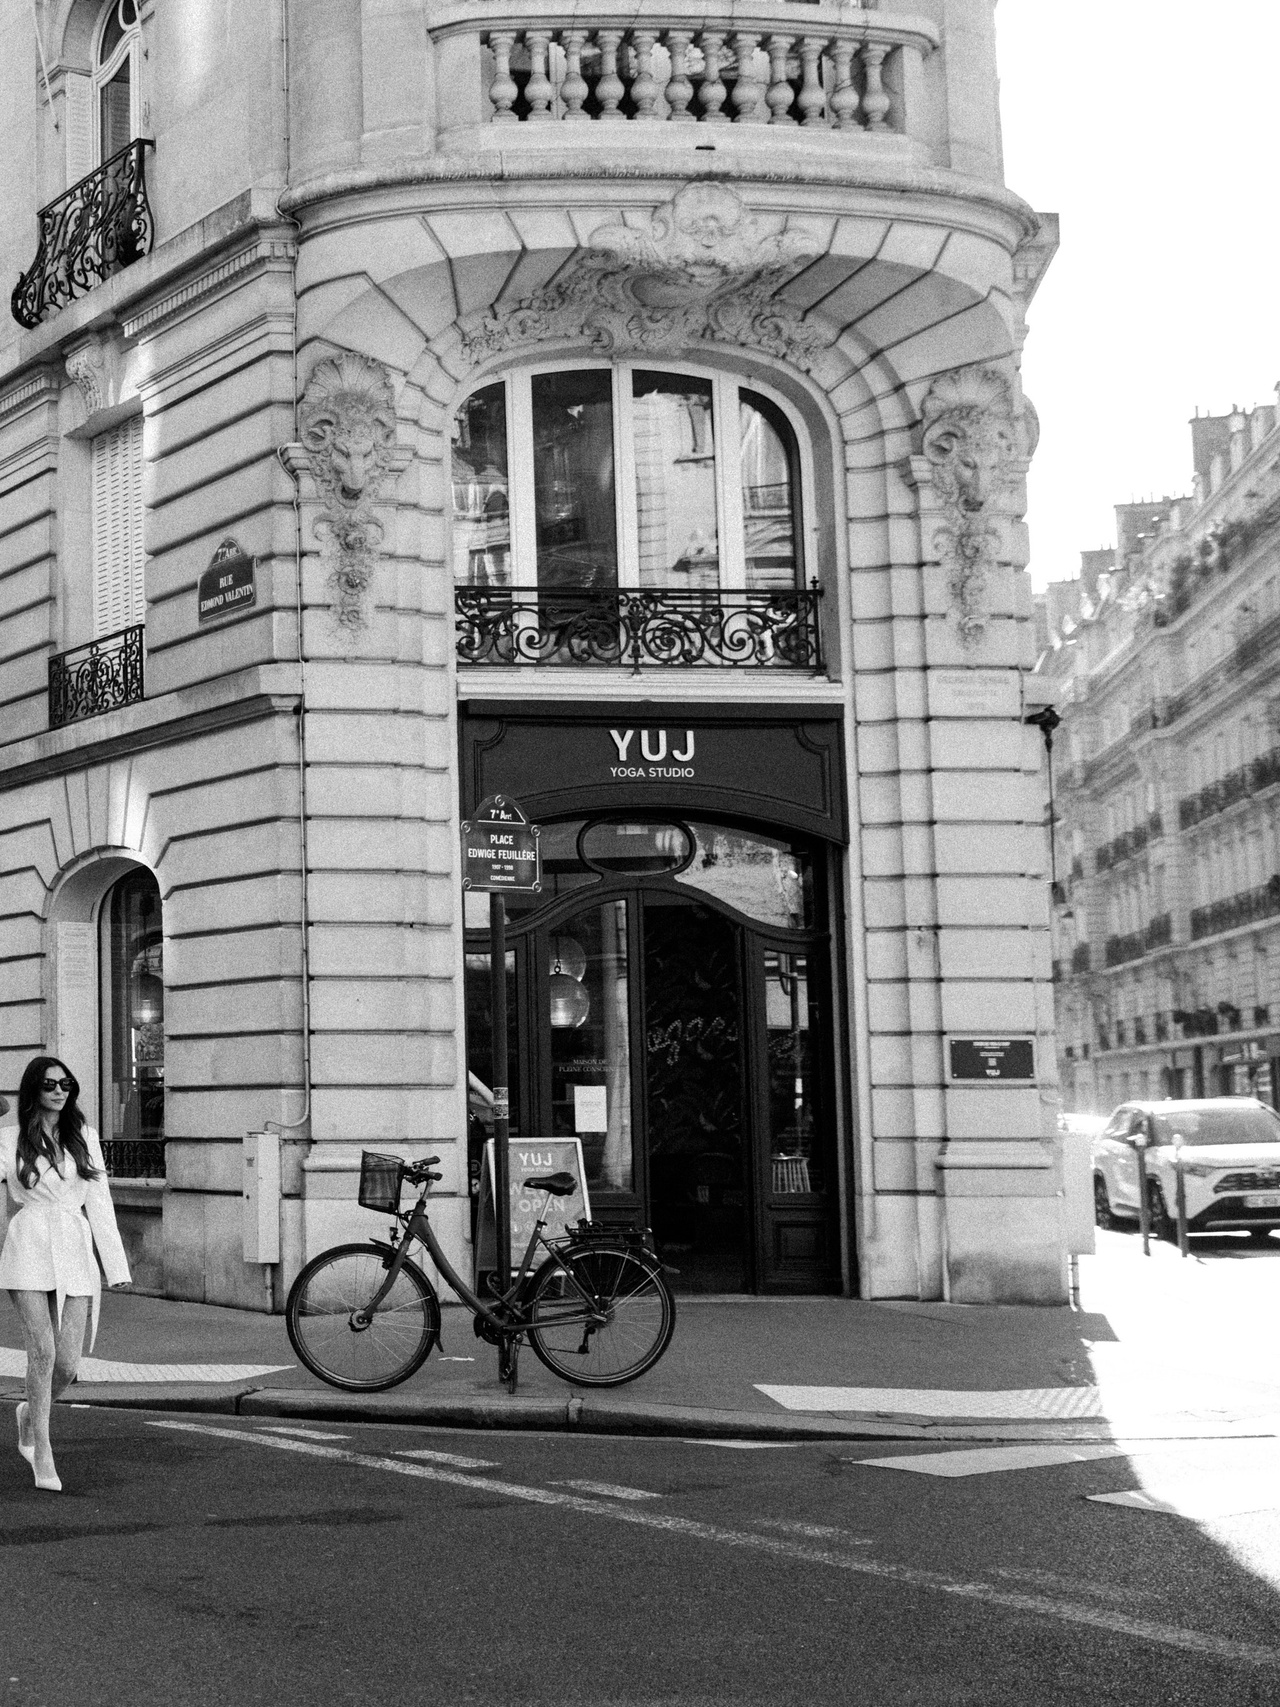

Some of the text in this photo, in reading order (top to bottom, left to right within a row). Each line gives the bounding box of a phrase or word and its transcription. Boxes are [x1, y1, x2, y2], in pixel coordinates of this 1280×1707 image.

[219, 574, 234, 589] RUE
[200, 594, 224, 613] EDMOND
[609, 729, 695, 762] YUJ
[610, 767, 695, 778] YOGA STUDIO
[490, 834, 514, 845] PLACE
[468, 848, 536, 861] EDWIGE FEUILLÈRE
[519, 1152, 553, 1167] YUJ
